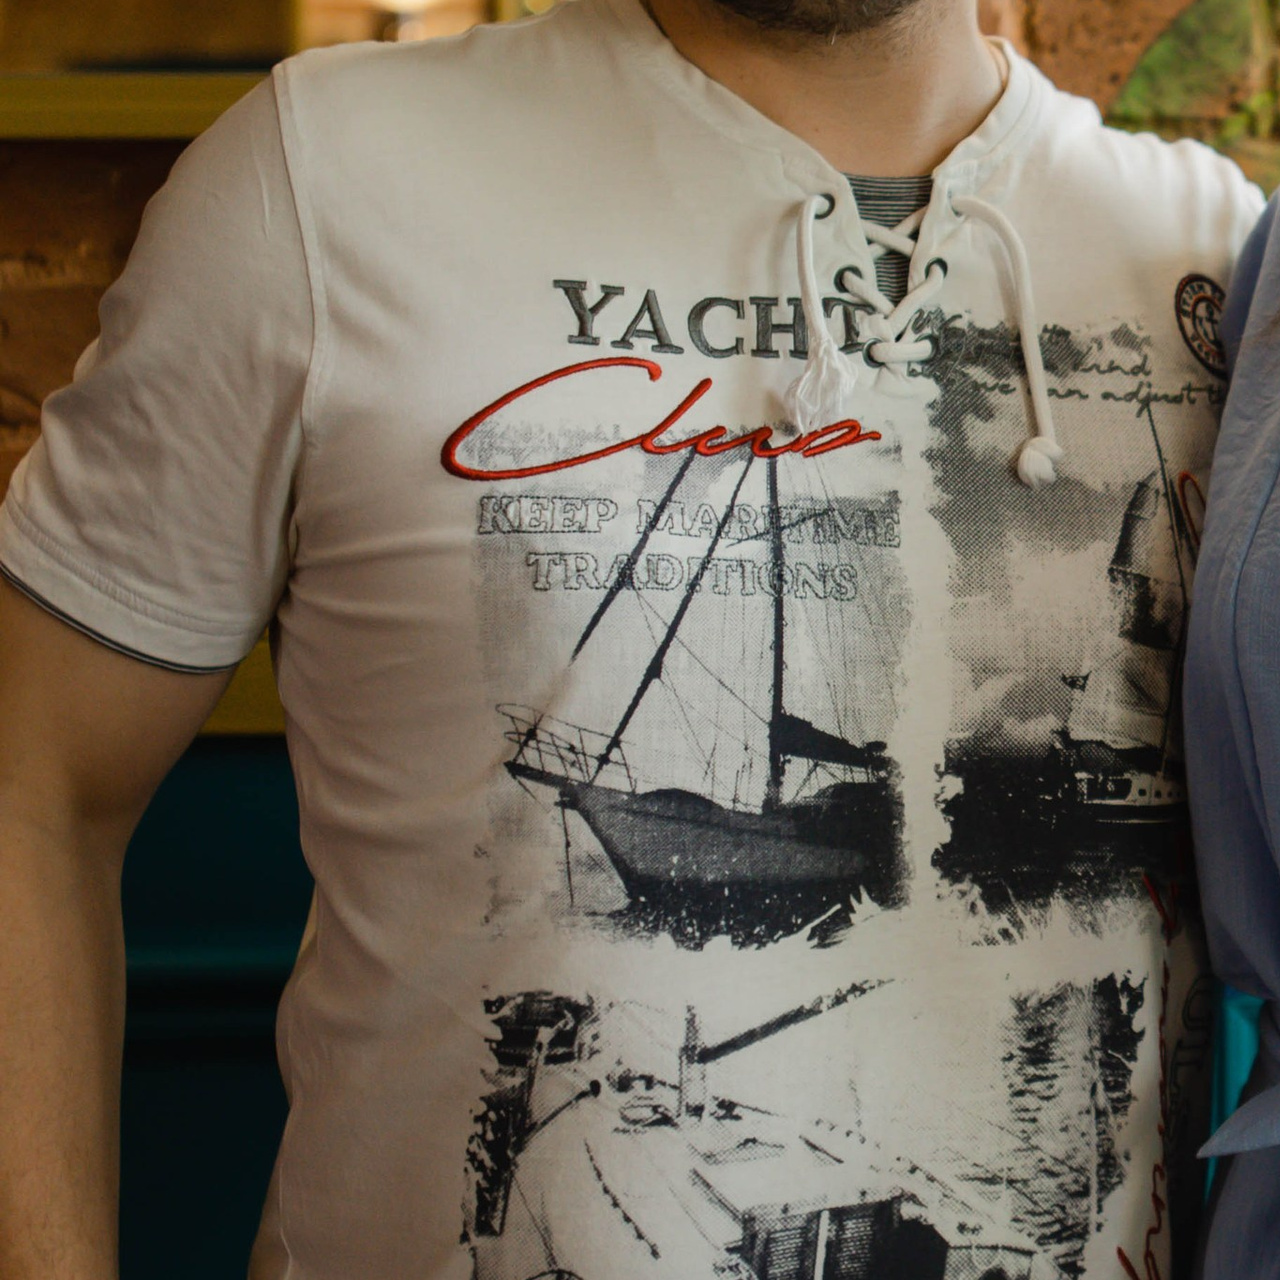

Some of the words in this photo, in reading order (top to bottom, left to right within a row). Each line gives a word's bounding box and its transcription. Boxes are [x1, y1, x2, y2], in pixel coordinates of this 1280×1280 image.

[553, 279, 876, 360] YACHT
[477, 495, 619, 535] KEEP
[526, 551, 859, 602] TRADITIONS
